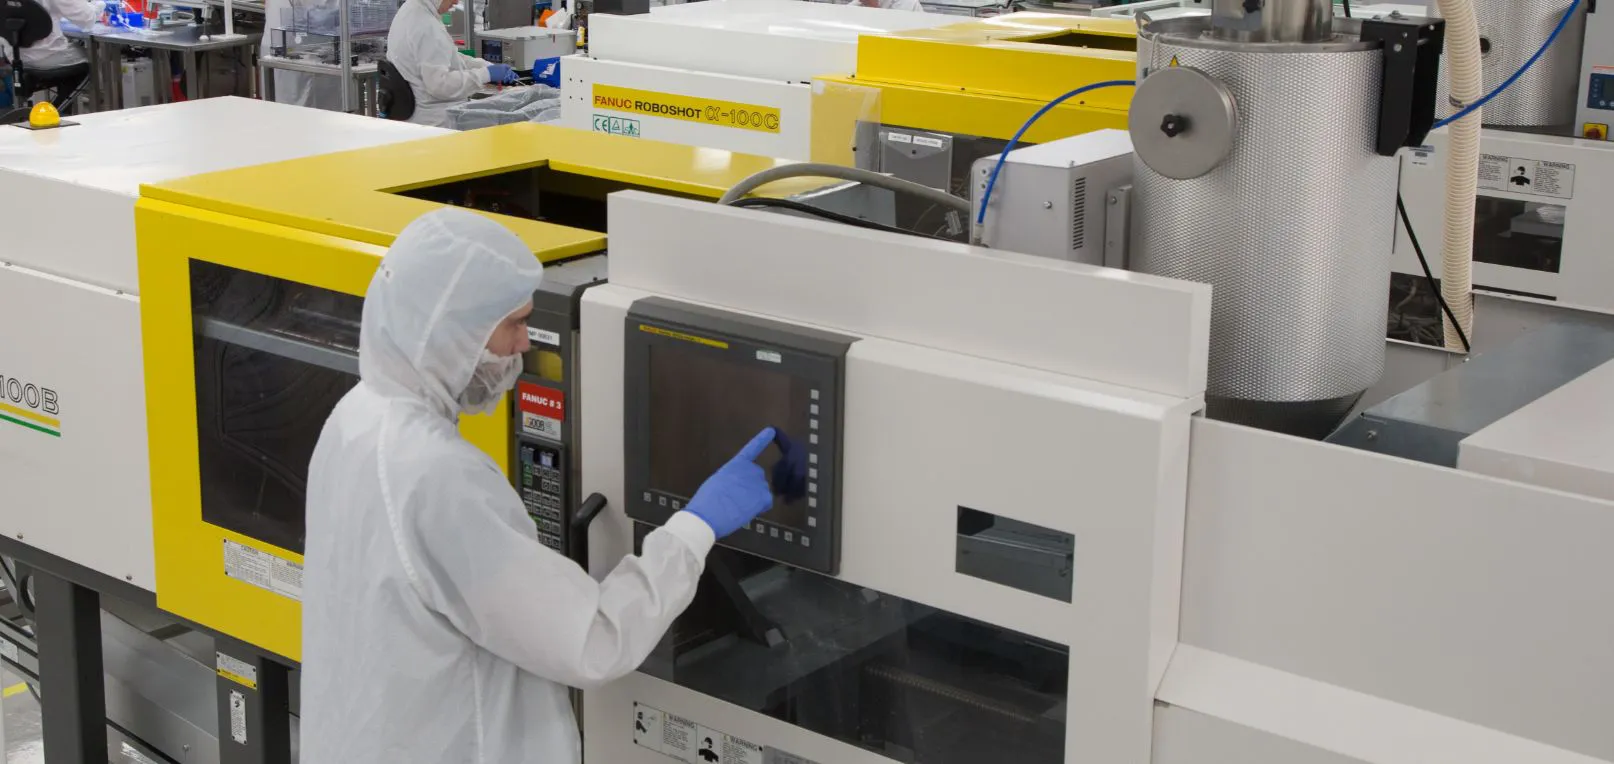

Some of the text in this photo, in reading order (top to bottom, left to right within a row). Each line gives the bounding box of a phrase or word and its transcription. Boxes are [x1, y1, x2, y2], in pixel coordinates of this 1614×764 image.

[594, 95, 632, 109] FANUC
[634, 101, 702, 118] ROBOSHOT
[521, 392, 548, 406] FANUC
[556, 401, 562, 410] 3
[668, 713, 695, 729] WARNING
[729, 735, 758, 752] WARNING
